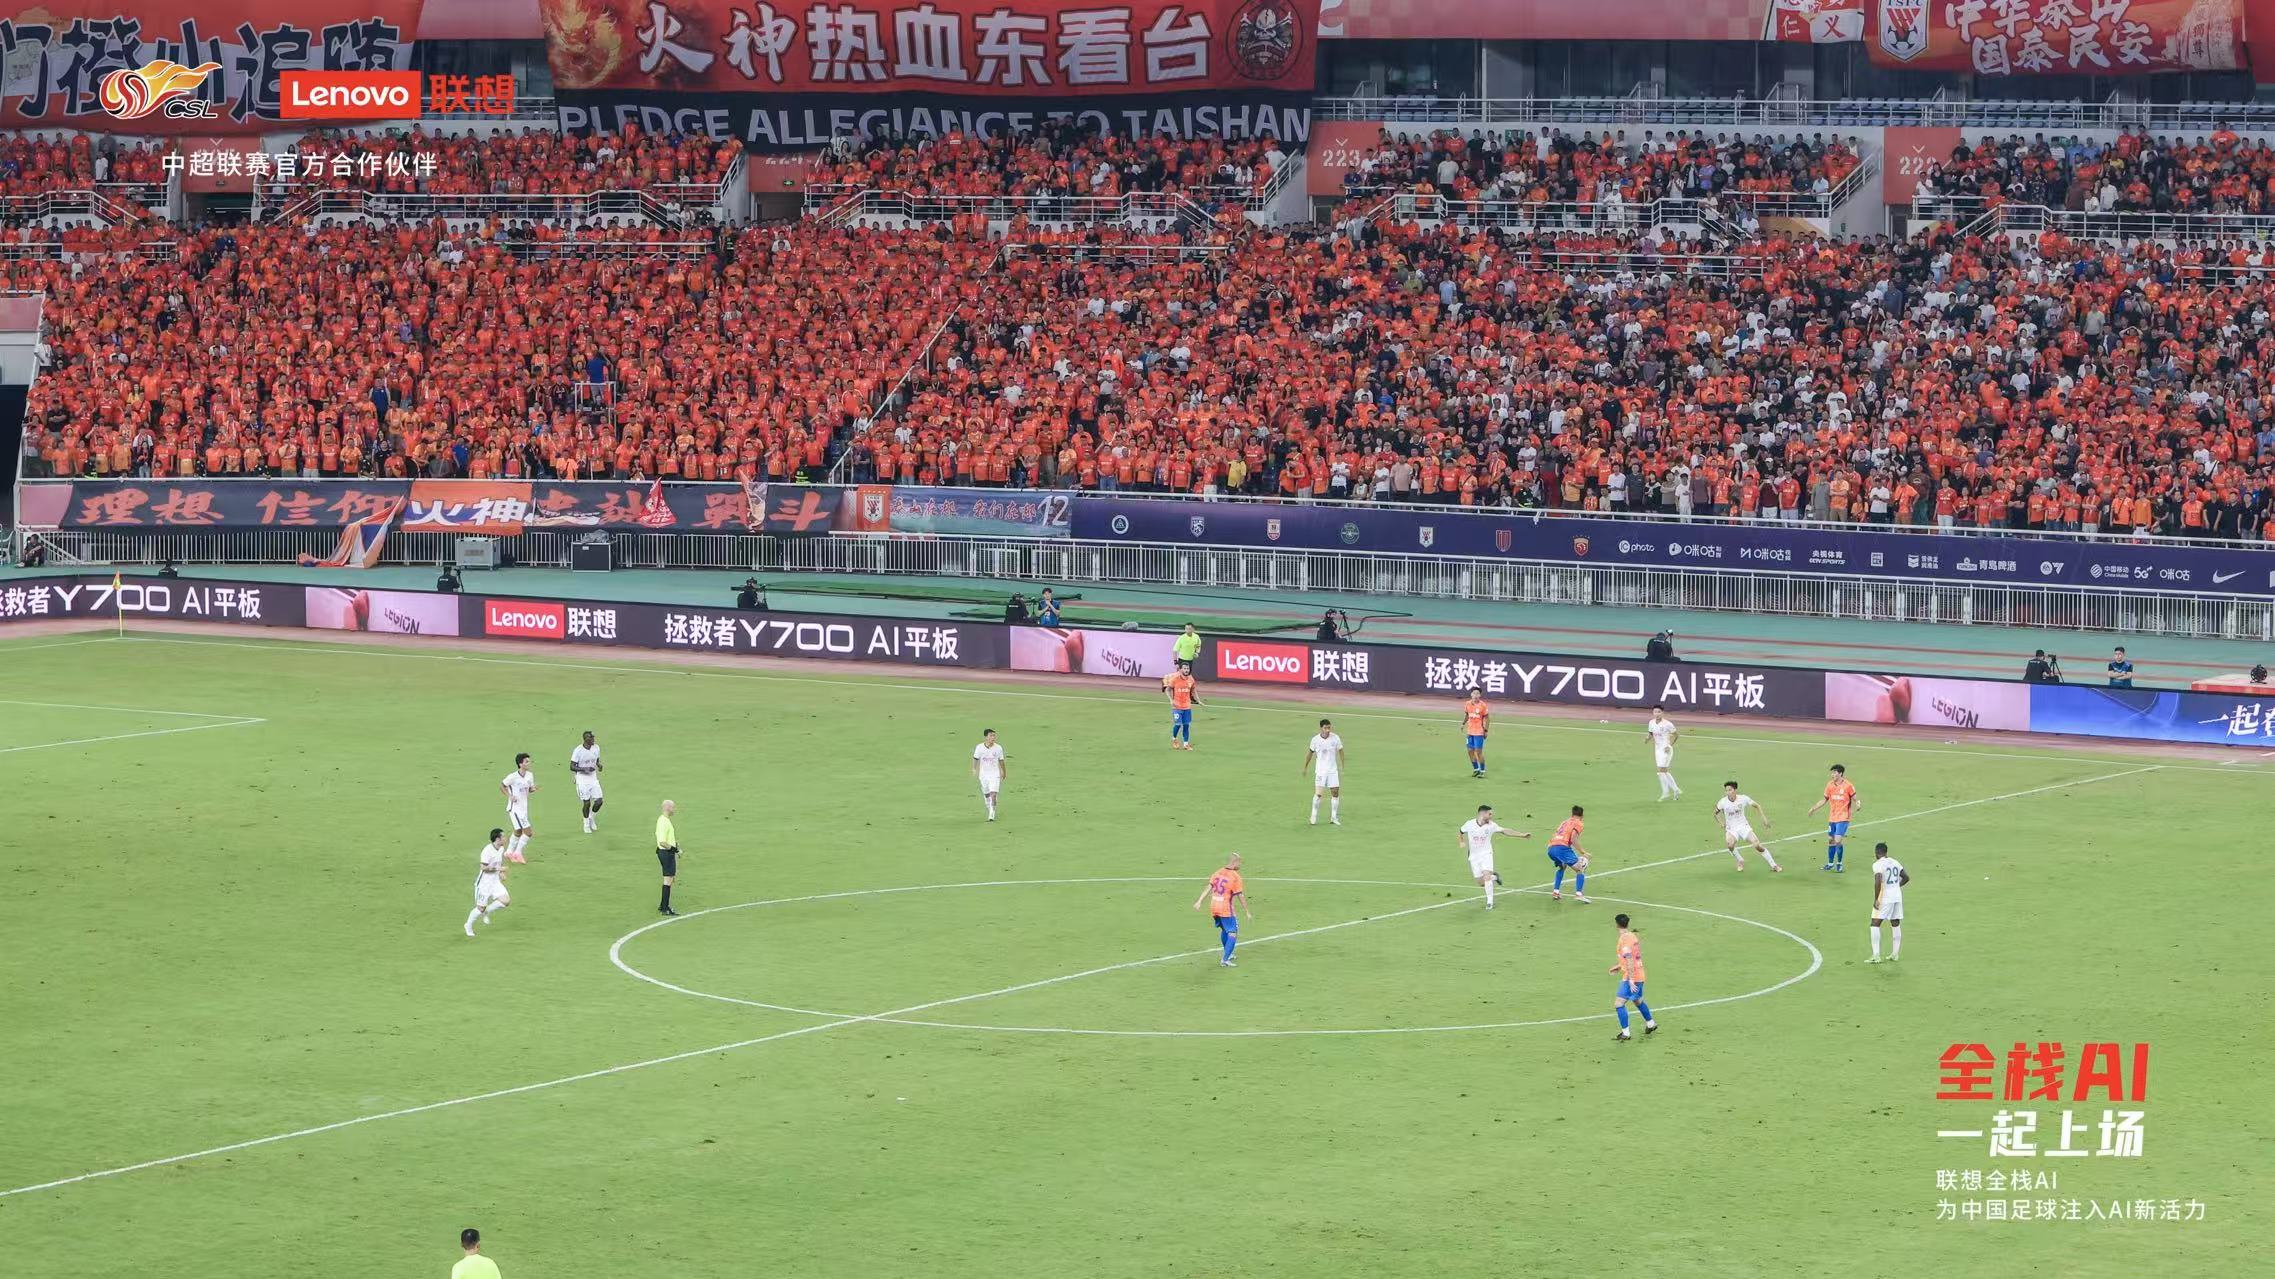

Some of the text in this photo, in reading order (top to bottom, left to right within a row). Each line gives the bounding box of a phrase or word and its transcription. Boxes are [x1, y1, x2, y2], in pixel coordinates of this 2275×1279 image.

[638, 2, 1212, 85] 火神热血东看台
[1971, 20, 2152, 76] 国泰民安
[1123, 104, 1311, 142] TAISHAN
[1322, 149, 1360, 167] 223
[75, 488, 225, 526] 理想
[404, 496, 530, 527] 火神
[1037, 495, 1069, 528] 12
[1979, 559, 2017, 572] 青岛啤酒
[0, 585, 262, 619] 救者Y700 AI平板
[384, 607, 420, 635] LEGION
[491, 605, 617, 639] Lenovo 联想
[664, 613, 960, 661] 拯救者Y700 AI平板
[1101, 648, 1142, 677] LEGION
[1225, 649, 1369, 684] Lenovo 联想
[1425, 656, 1766, 710] 拯救者Y700 AI平板
[1931, 696, 1980, 729] LEGION
[1886, 866, 1899, 884] 29
